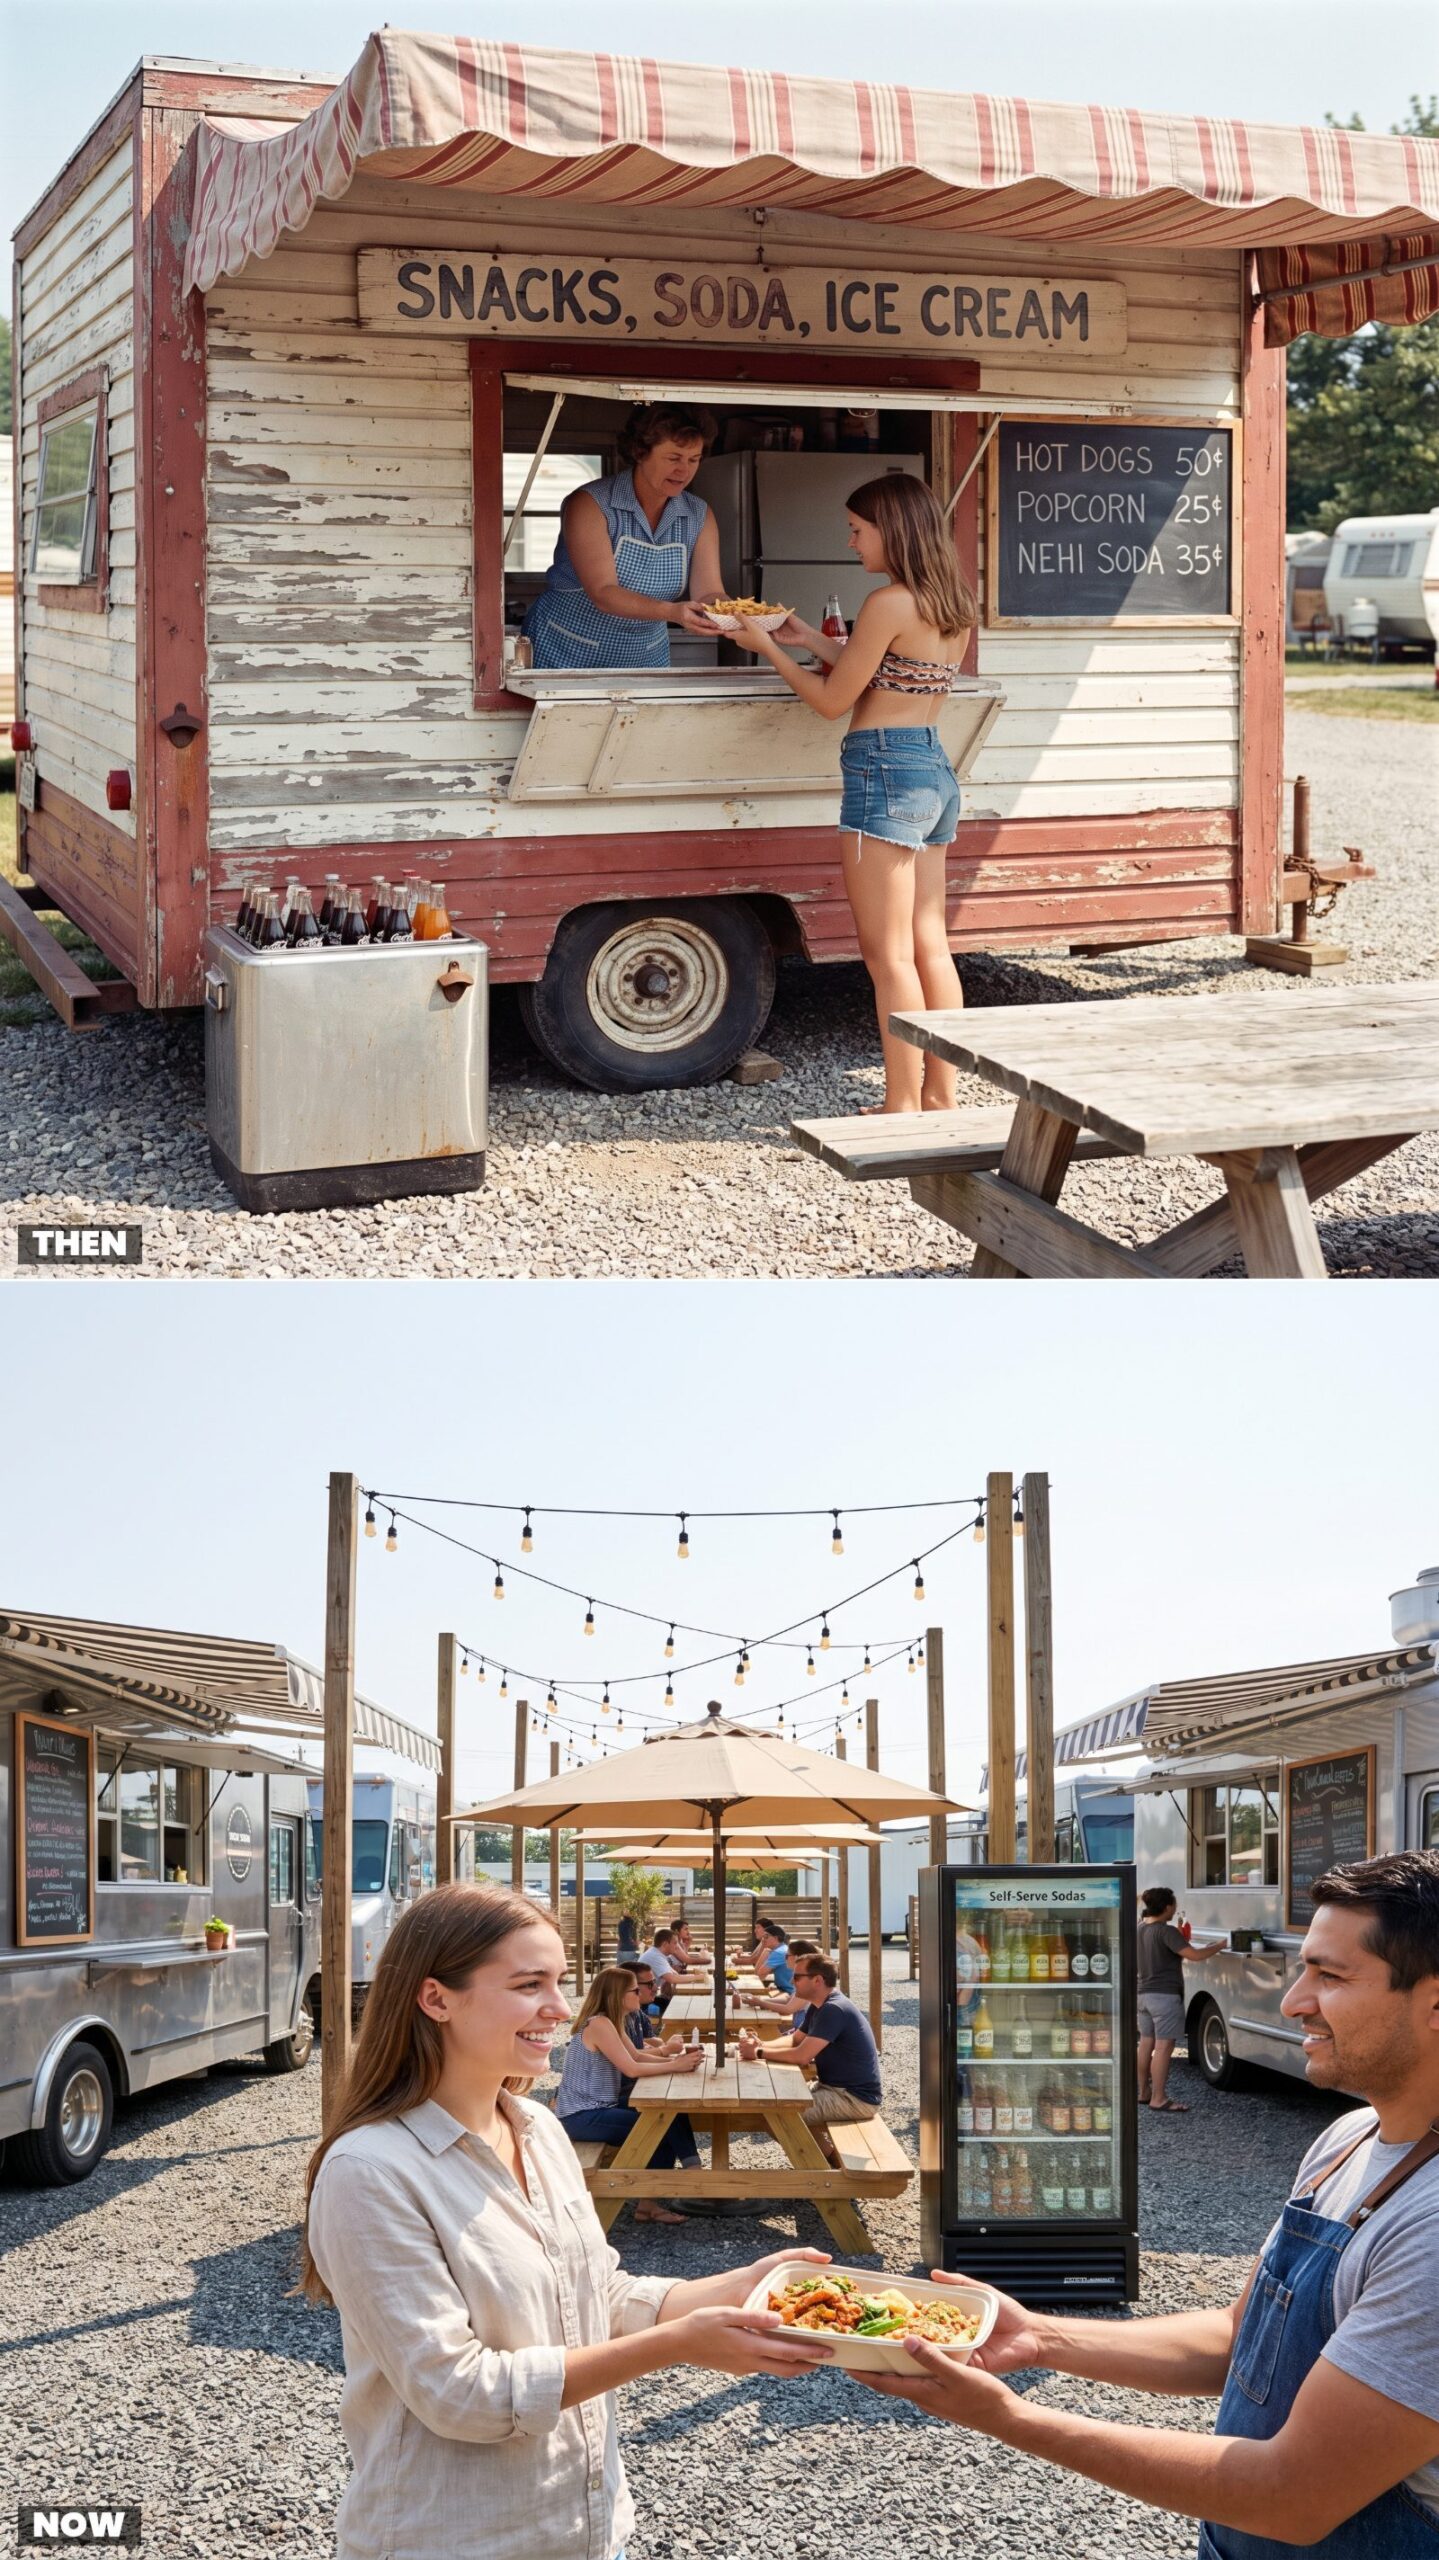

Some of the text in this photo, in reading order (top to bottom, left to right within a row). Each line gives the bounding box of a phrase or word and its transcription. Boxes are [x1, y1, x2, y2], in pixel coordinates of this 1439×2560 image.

[397, 262, 1090, 342] SNACKS, SODA, ICE CREAM
[1016, 441, 1224, 477] HOT DOGS 50¢
[1017, 490, 1223, 524] POPCORN 25¢
[1018, 541, 1223, 575] NEHI SODA 35¢
[989, 1890, 1086, 1902] Self-Serve Sodas
